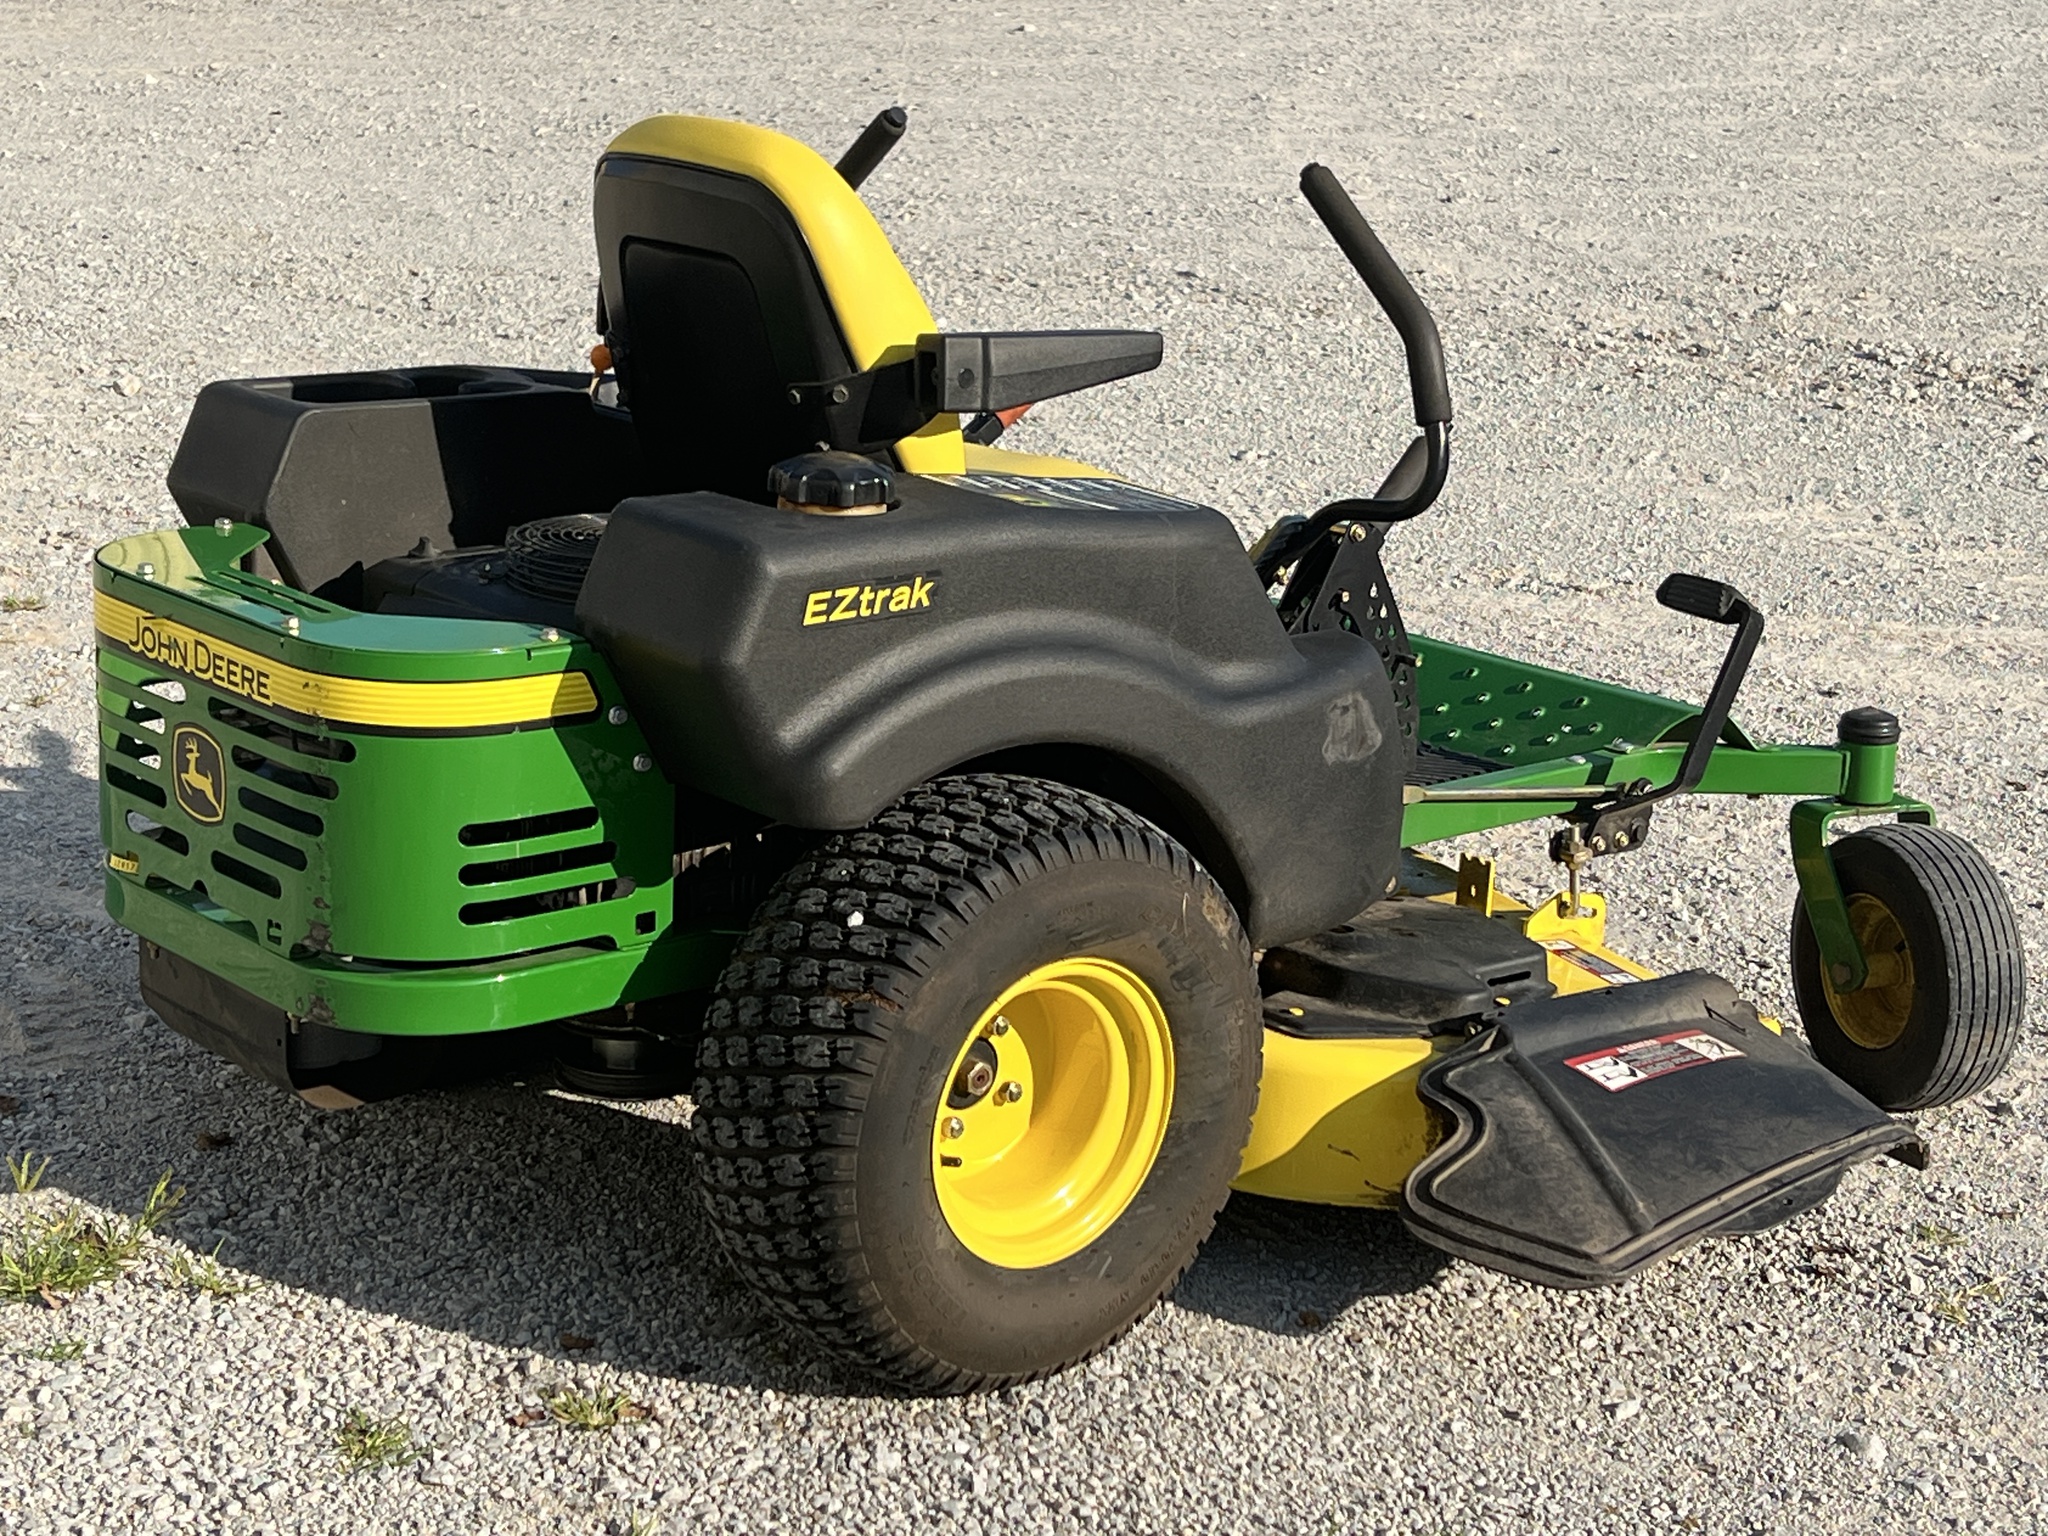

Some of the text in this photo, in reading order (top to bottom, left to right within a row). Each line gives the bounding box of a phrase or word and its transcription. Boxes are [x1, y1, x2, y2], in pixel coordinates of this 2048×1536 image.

[803, 576, 935, 627] EZtrak
[129, 615, 271, 700] JOHN DEERE
